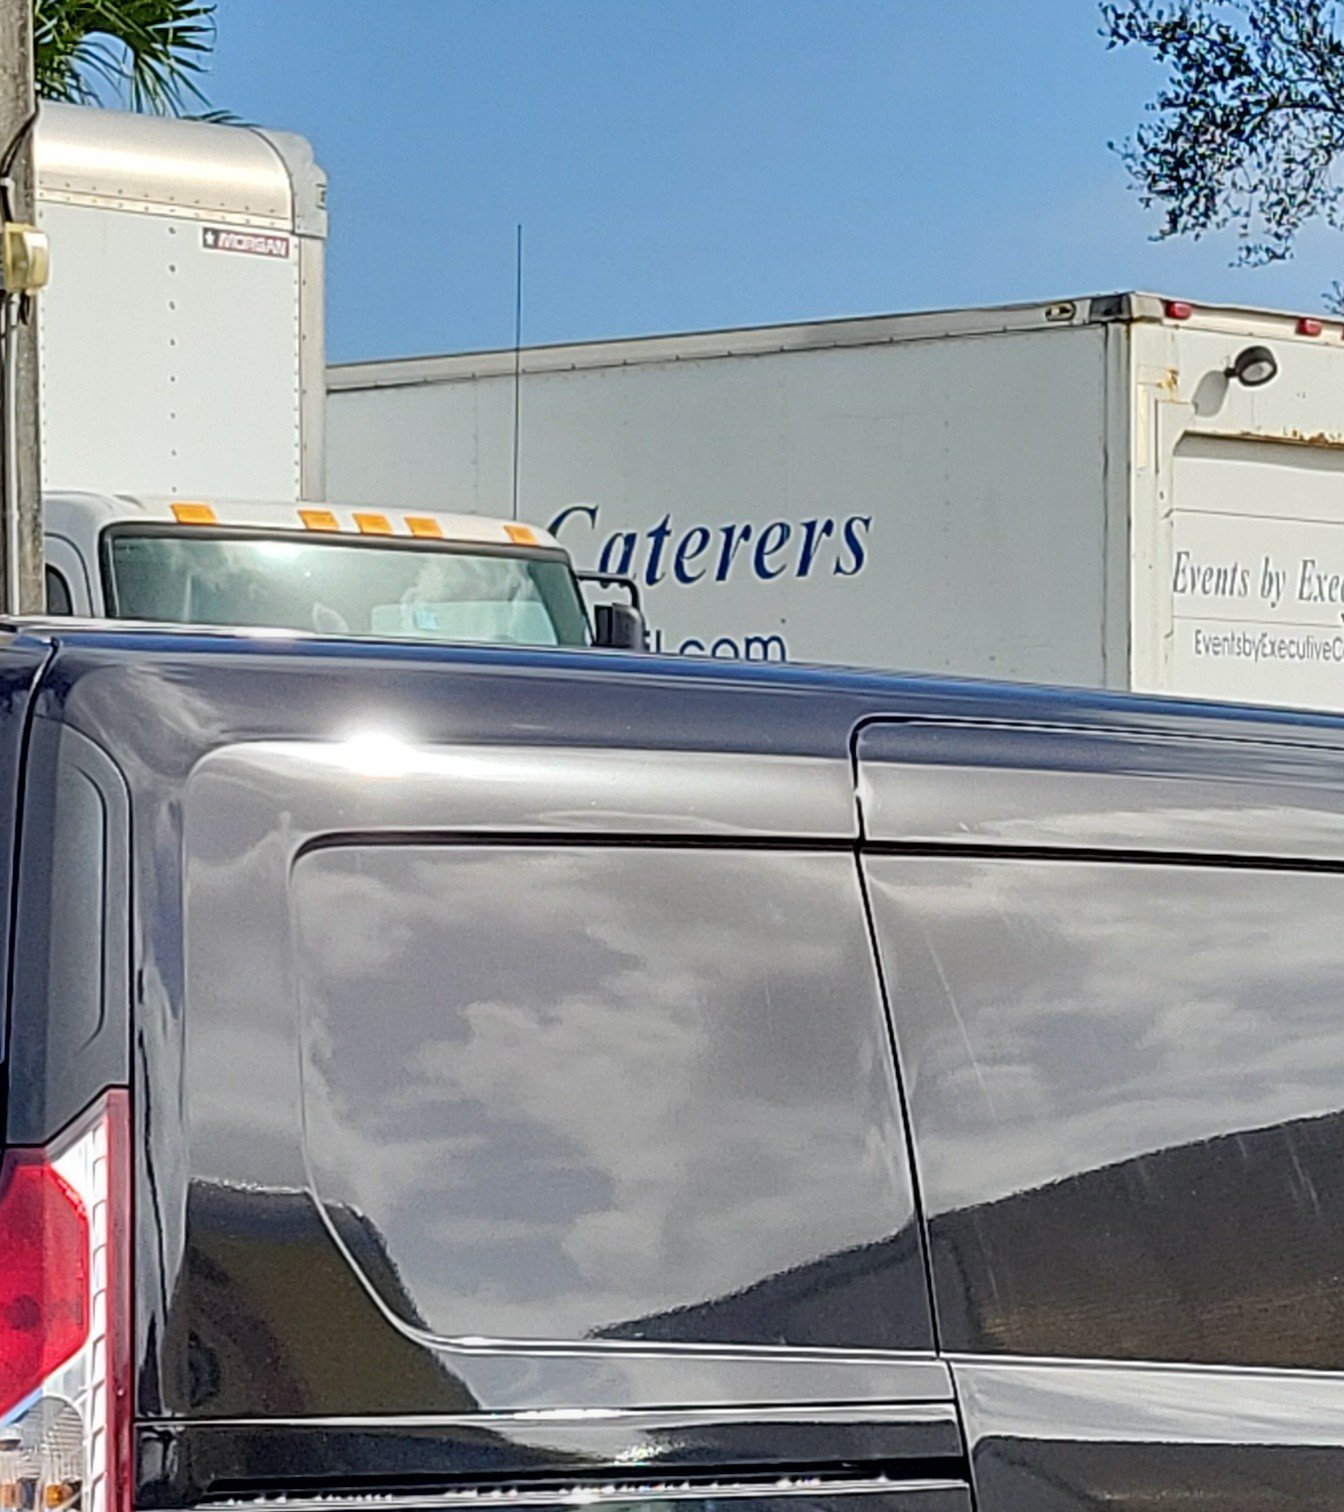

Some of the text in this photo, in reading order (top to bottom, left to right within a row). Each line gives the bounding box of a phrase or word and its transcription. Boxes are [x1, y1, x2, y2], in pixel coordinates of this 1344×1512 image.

[217, 231, 287, 256] MORGAN
[1173, 550, 1250, 598] Events
[1261, 556, 1286, 608] by
